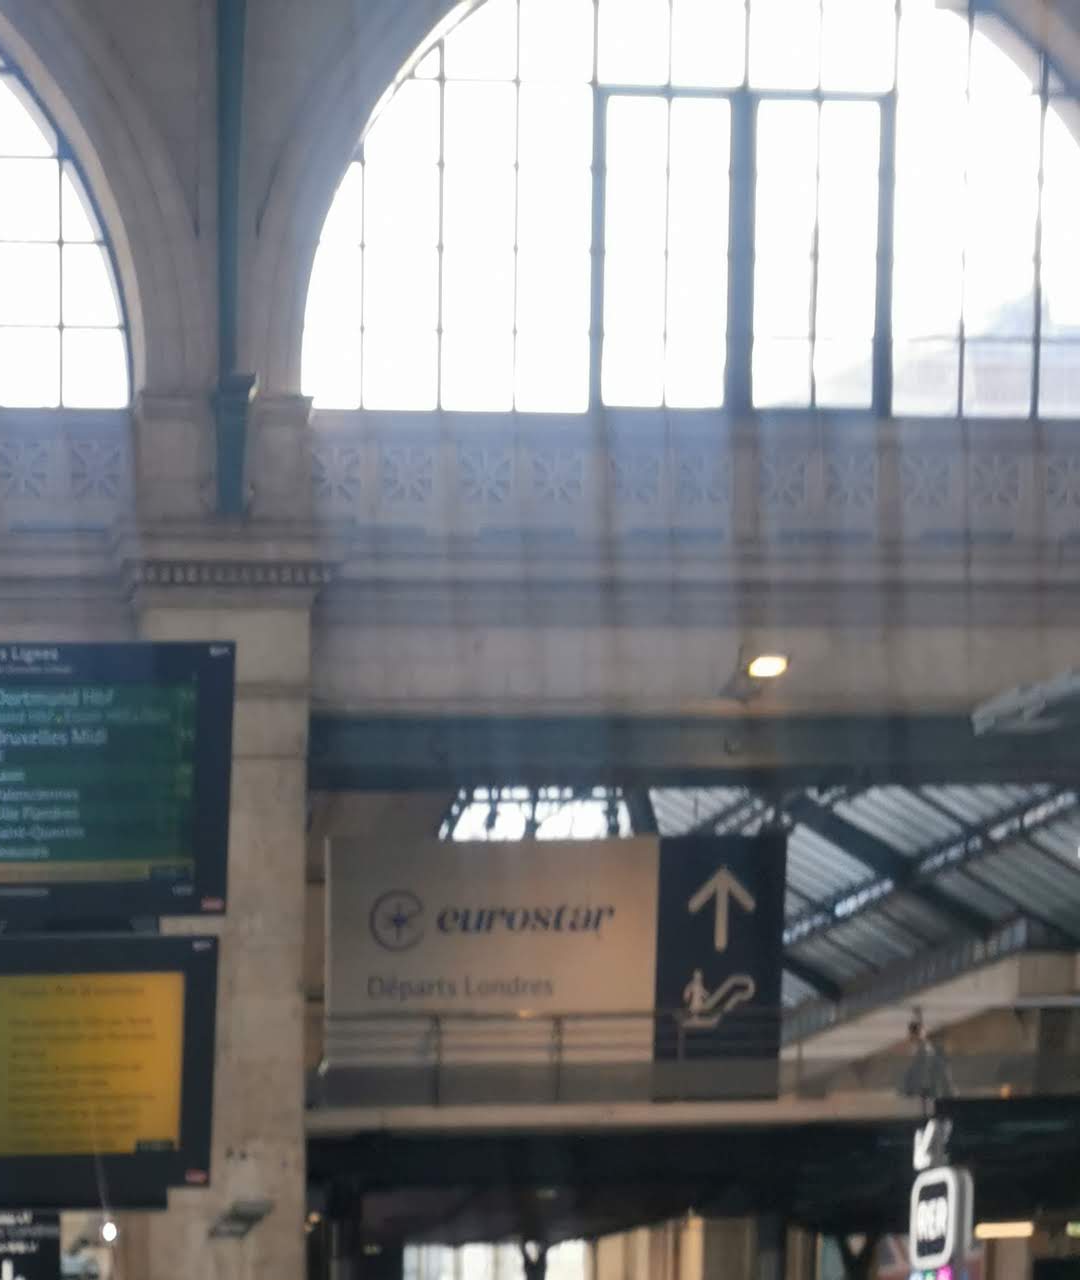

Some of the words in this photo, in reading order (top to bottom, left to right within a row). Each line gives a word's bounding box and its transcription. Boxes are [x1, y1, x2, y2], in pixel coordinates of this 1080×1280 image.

[11, 646, 59, 664] Lignes
[434, 902, 617, 936] eurostar
[367, 974, 457, 1002] Départs
[465, 975, 554, 997] Londres
[917, 1196, 948, 1242] RER
